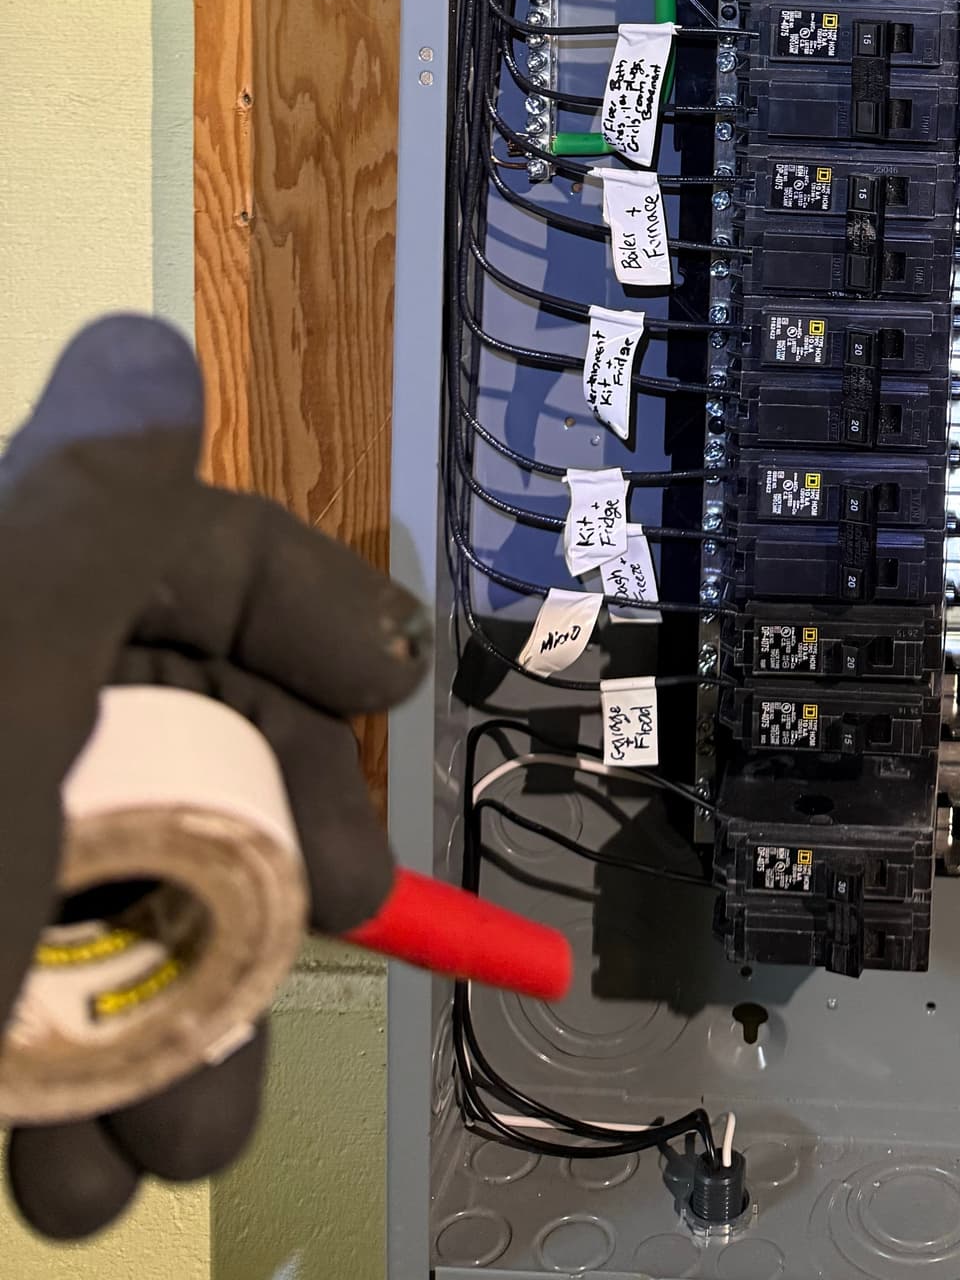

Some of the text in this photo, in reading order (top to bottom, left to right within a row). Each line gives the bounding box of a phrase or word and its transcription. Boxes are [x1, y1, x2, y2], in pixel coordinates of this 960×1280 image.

[863, 33, 872, 45] 15
[774, 164, 783, 190] DP-4075
[858, 188, 867, 200] 15
[814, 347, 822, 363] HOM
[854, 343, 863, 356] 20
[850, 420, 859, 432] 20
[850, 499, 859, 512] 20
[599, 498, 620, 547] Fridge
[847, 575, 856, 588] 20
[846, 656, 855, 669] 20
[844, 733, 853, 745] 15
[837, 880, 847, 894] 30
